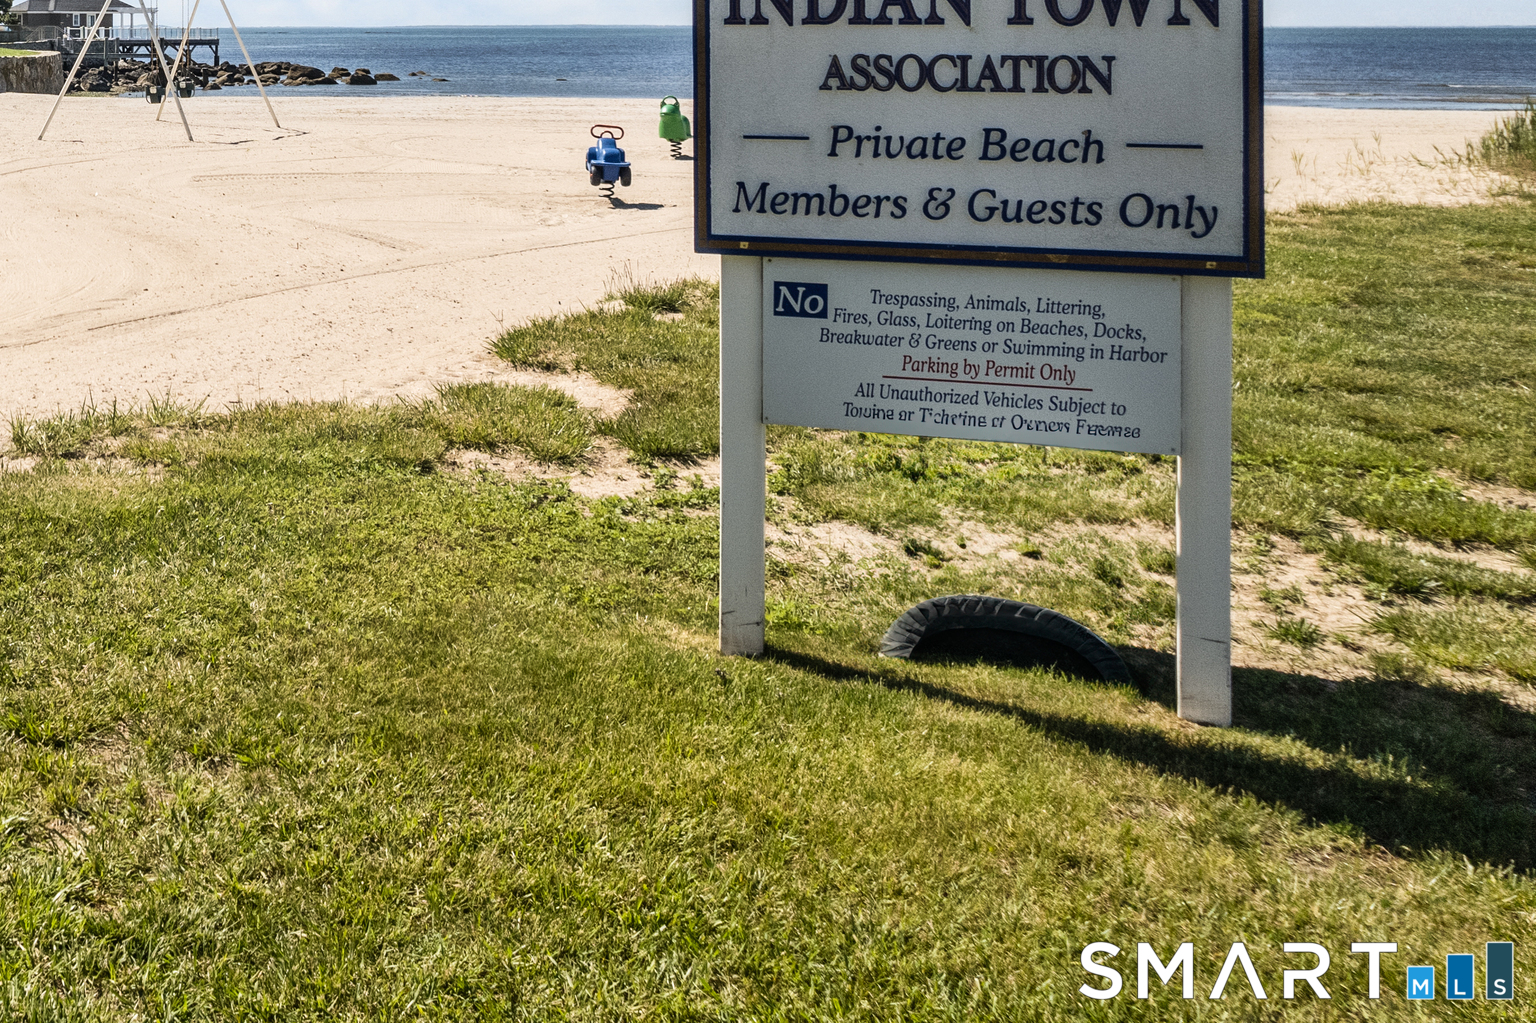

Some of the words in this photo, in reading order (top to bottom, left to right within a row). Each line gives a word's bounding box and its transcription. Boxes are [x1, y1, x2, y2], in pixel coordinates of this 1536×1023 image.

[819, 53, 1116, 95] ASSOCIATION
[827, 125, 966, 160] Private
[978, 127, 1106, 164] Beach
[732, 181, 908, 219] Members
[922, 187, 956, 221] &
[967, 188, 1104, 226] Guests
[1119, 192, 1219, 239] Only
[775, 286, 825, 314] No
[870, 289, 960, 312] Trespassing,
[964, 294, 1032, 315] Animals,
[1035, 297, 1107, 320] Littering,
[832, 308, 873, 327] Fires,
[876, 310, 921, 330] Glass,
[925, 313, 992, 336] Loitering
[996, 320, 1016, 333] on
[1019, 318, 1089, 340] Beaches,
[1093, 322, 1148, 342] Docks,
[819, 328, 905, 347] Breakwater
[908, 333, 922, 349] &
[925, 334, 978, 352] Greens
[981, 340, 999, 353] or
[1002, 338, 1086, 362] Swimming
[1089, 343, 1105, 359] in
[1108, 345, 1168, 364] Harbor
[902, 355, 959, 378] Parking
[963, 358, 981, 379] by
[984, 359, 1036, 380] Permit
[1039, 363, 1076, 386] Only
[854, 382, 875, 398] All
[879, 383, 980, 406] Unauthorized
[983, 391, 1044, 410] Vehicles
[1048, 395, 1107, 417] Subject
[1110, 402, 1127, 416] to
